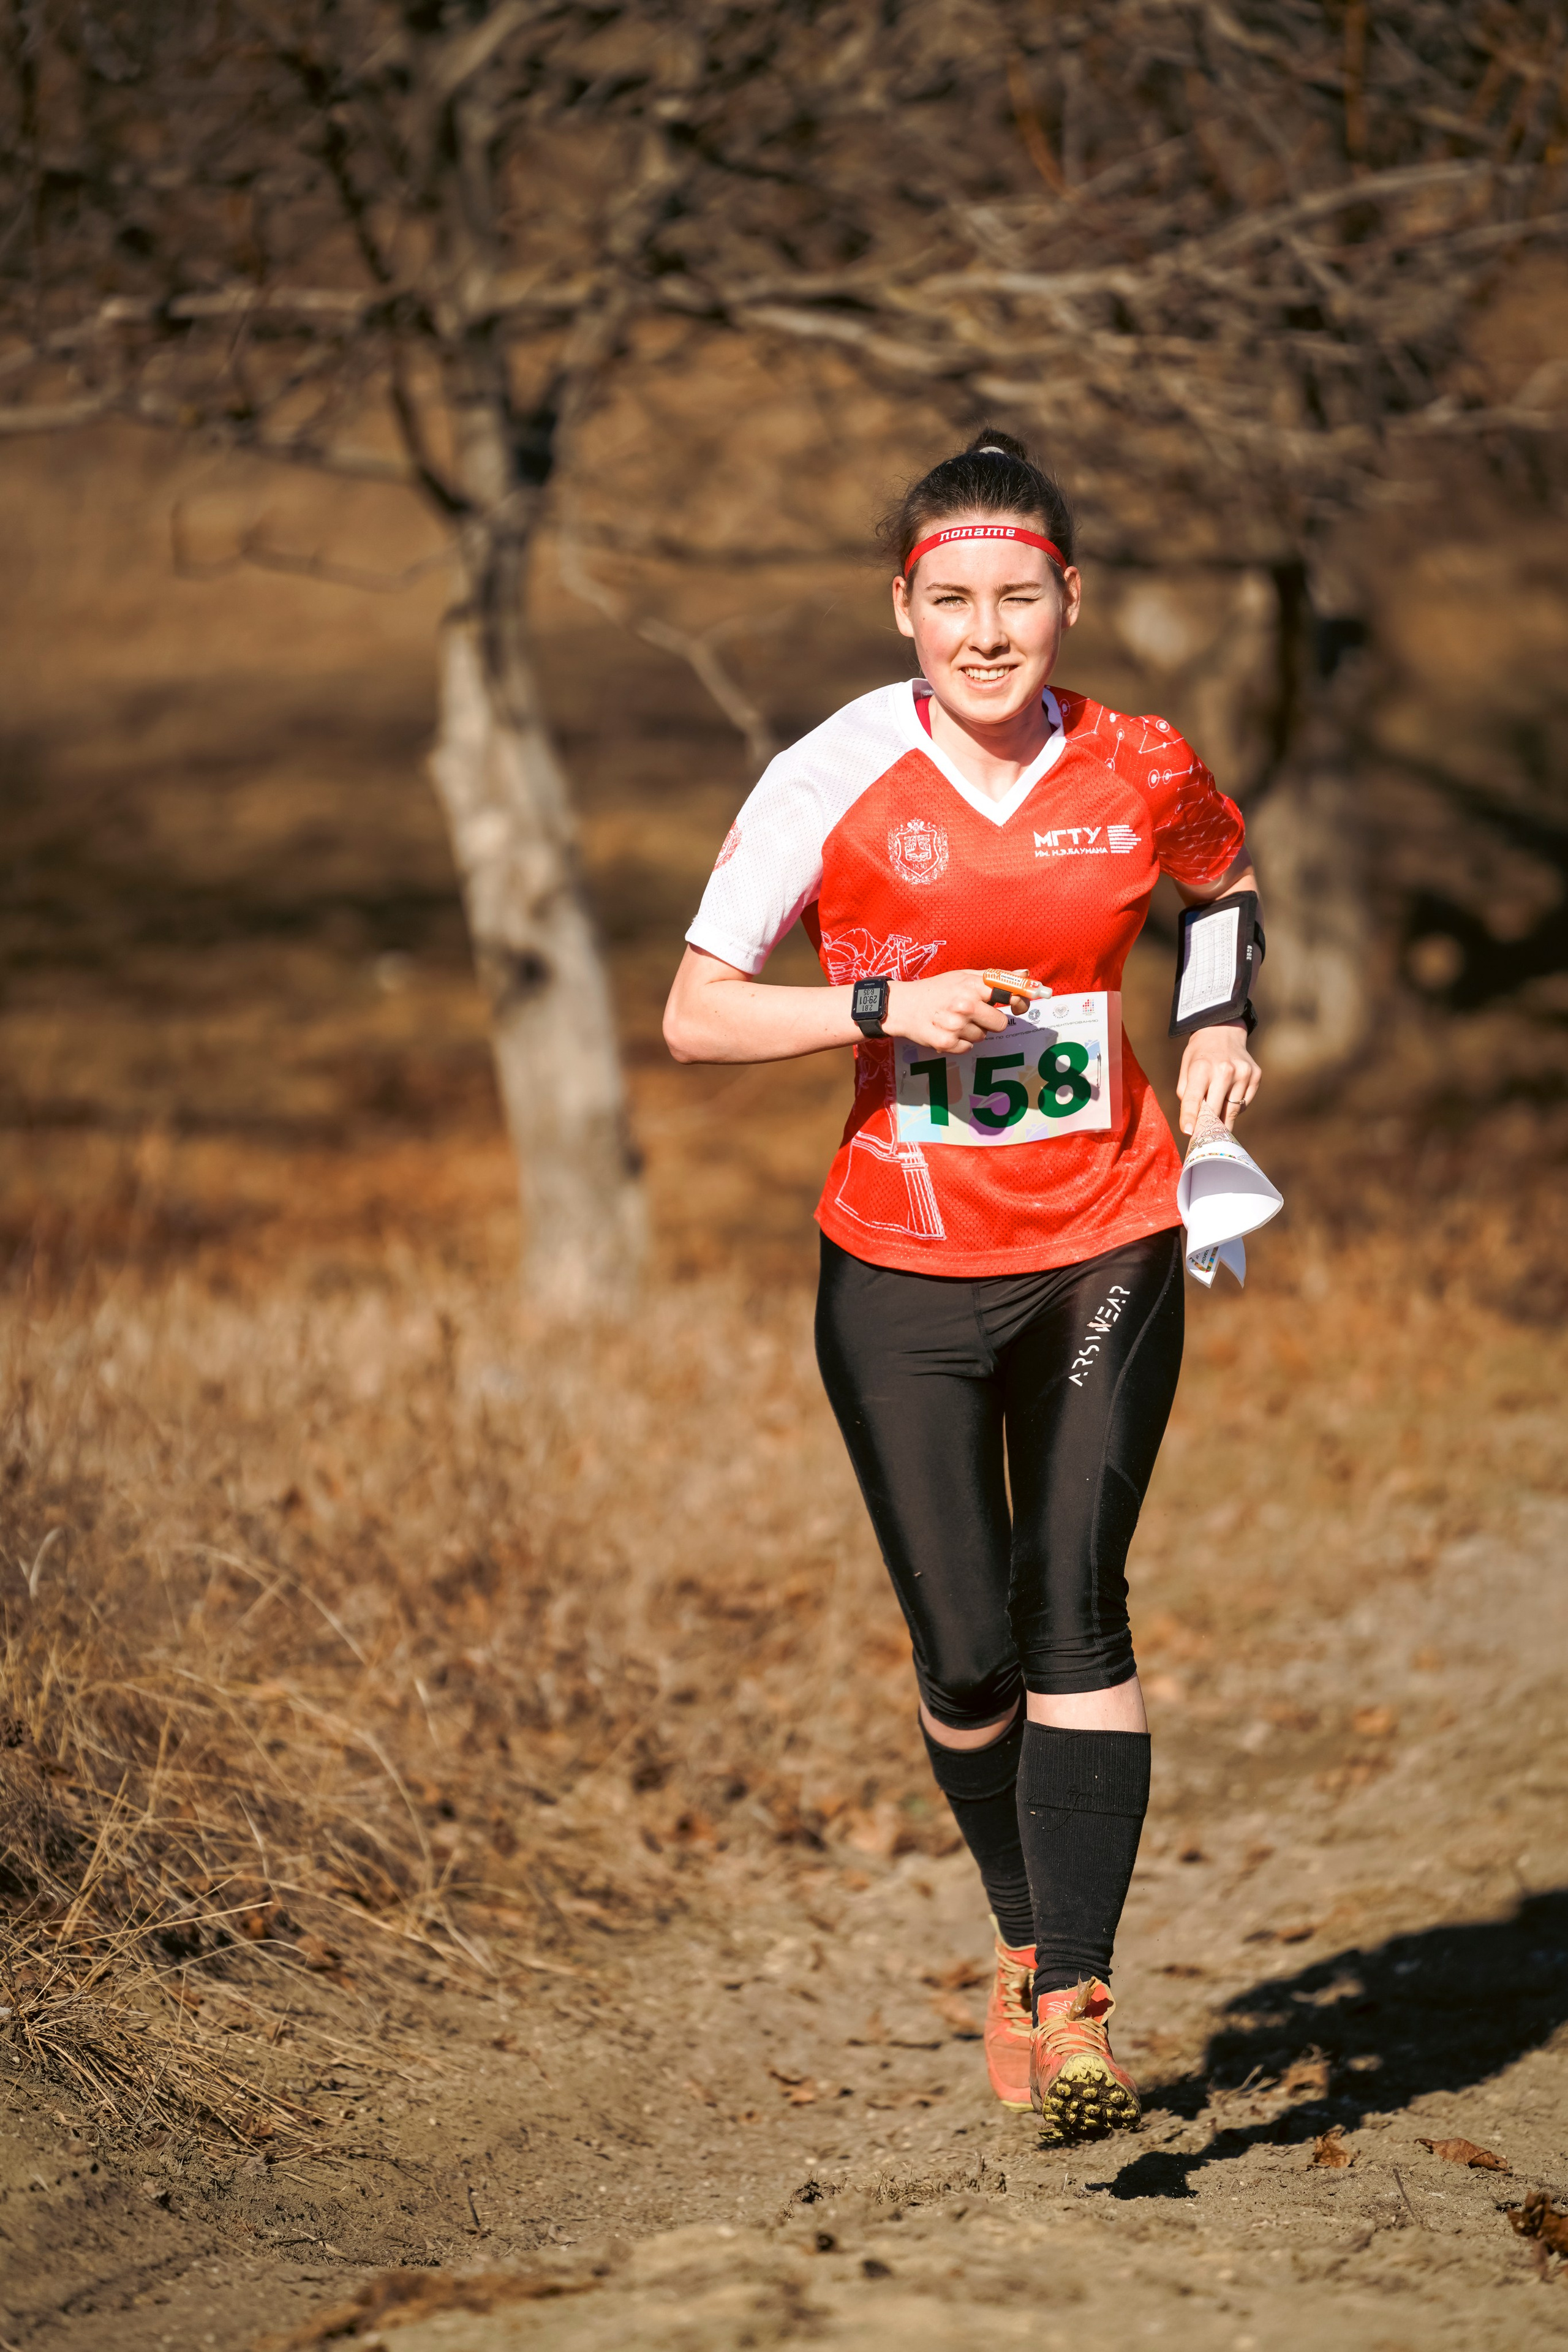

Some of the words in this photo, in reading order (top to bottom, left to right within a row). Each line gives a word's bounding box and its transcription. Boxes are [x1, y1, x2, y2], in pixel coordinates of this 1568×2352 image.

[939, 527, 1016, 542] noname
[1033, 826, 1102, 848] МГТУ
[859, 995, 878, 1005] 29:01
[1006, 1028, 1045, 1038] СПОРТИВНОМУ
[910, 1041, 1091, 1128] 158
